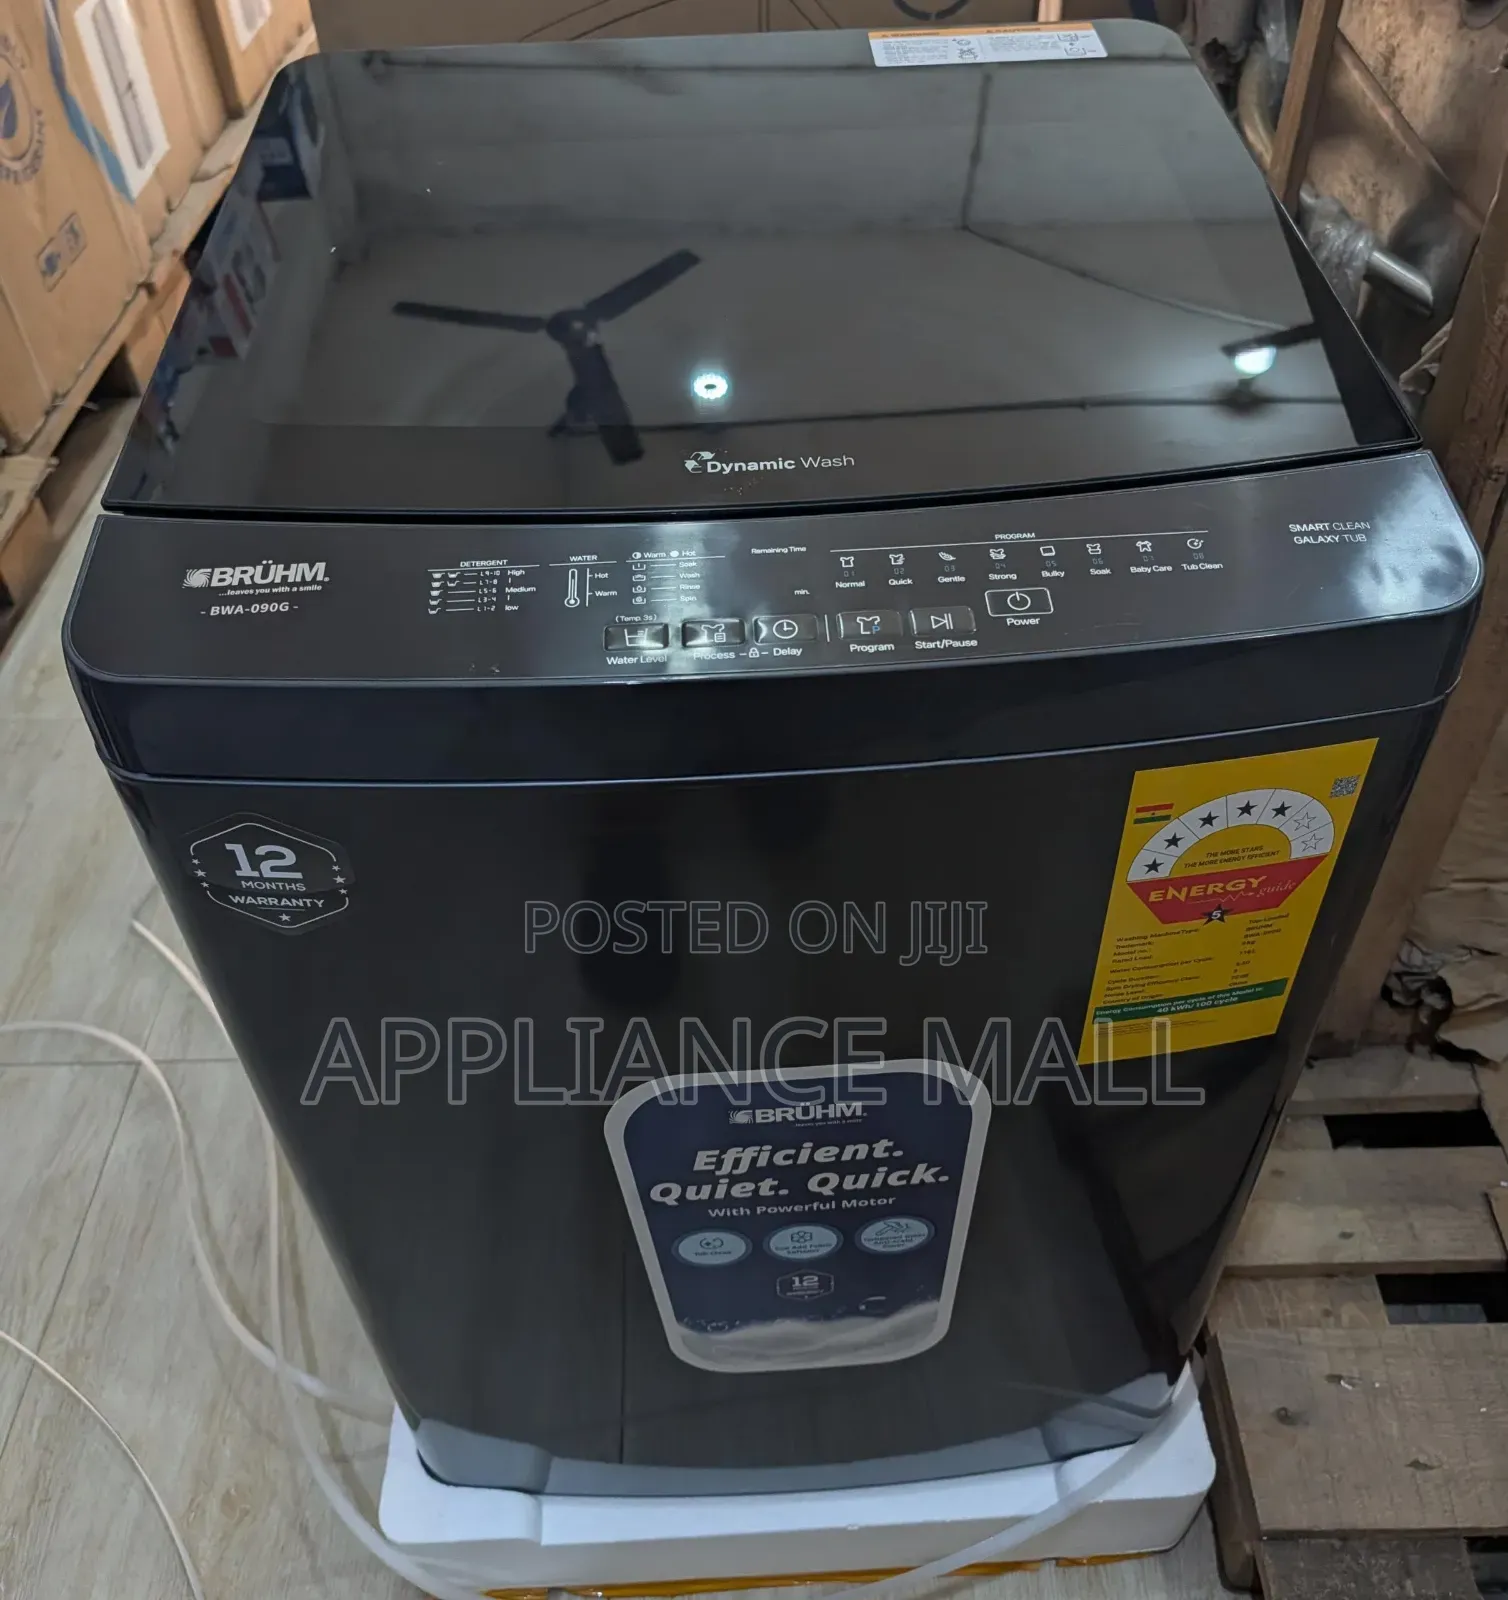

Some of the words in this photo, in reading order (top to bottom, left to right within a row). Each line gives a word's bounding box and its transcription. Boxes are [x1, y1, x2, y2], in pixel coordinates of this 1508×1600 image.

[706, 458, 796, 474] Dynamic
[800, 455, 855, 468] Wash
[1288, 522, 1330, 532] SMART
[1332, 522, 1371, 531] CLEAN
[994, 532, 1036, 540] PROGRAM
[1293, 534, 1340, 544] GALAXY
[1342, 534, 1367, 542] TUB
[569, 554, 598, 562] WATER
[460, 560, 508, 568] DETERGENT
[1199, 562, 1224, 570] Clean
[1041, 570, 1065, 578] Bulky
[1130, 566, 1151, 574] Baby
[835, 580, 866, 588] Normal
[888, 578, 913, 586] Quick
[254, 588, 270, 596] you
[298, 584, 322, 592] smile
[210, 602, 290, 616] BWA-090G
[1006, 618, 1041, 626] Power
[850, 643, 895, 653] Program
[915, 640, 978, 650] Start/Pause
[693, 652, 736, 661] Process
[773, 647, 803, 657] Delay
[606, 656, 637, 665] Water
[640, 654, 668, 663] Level
[1206, 850, 1219, 859] THE
[1220, 848, 1240, 857] MORE
[1241, 845, 1264, 854] STARS
[224, 843, 304, 879] 12
[1184, 860, 1197, 868] THE
[1198, 858, 1218, 868] MORE
[1219, 854, 1246, 864] ENERGY
[1246, 850, 1281, 860] EFFICIENT
[240, 880, 306, 892] MONTHS
[1148, 875, 1268, 904] ENERGY
[1256, 879, 1296, 898] guide
[228, 894, 325, 908] WARRANTY
[1210, 910, 1222, 919] 5
[1116, 934, 1148, 942] Washing
[1113, 948, 1137, 956] Model
[1112, 956, 1133, 964] Rated
[1132, 962, 1180, 972] Consumption
[1122, 982, 1146, 990] Drying
[1096, 1008, 1122, 1016] Energy
[1123, 1002, 1172, 1012] Consumption
[1187, 996, 1207, 1004] cycle
[1232, 988, 1255, 996] Model
[1102, 996, 1132, 1004] Country
[1156, 1006, 1168, 1014] 40
[1196, 1000, 1213, 1008] 100
[1214, 996, 1239, 1005] cycle
[694, 1138, 904, 1176] Efficient.
[650, 1178, 789, 1206] Quiet.
[807, 1162, 950, 1196] Quick.
[708, 1206, 751, 1218] With
[756, 1200, 836, 1216] Powerful
[841, 1196, 896, 1209] Motor
[791, 1276, 820, 1287] 12
